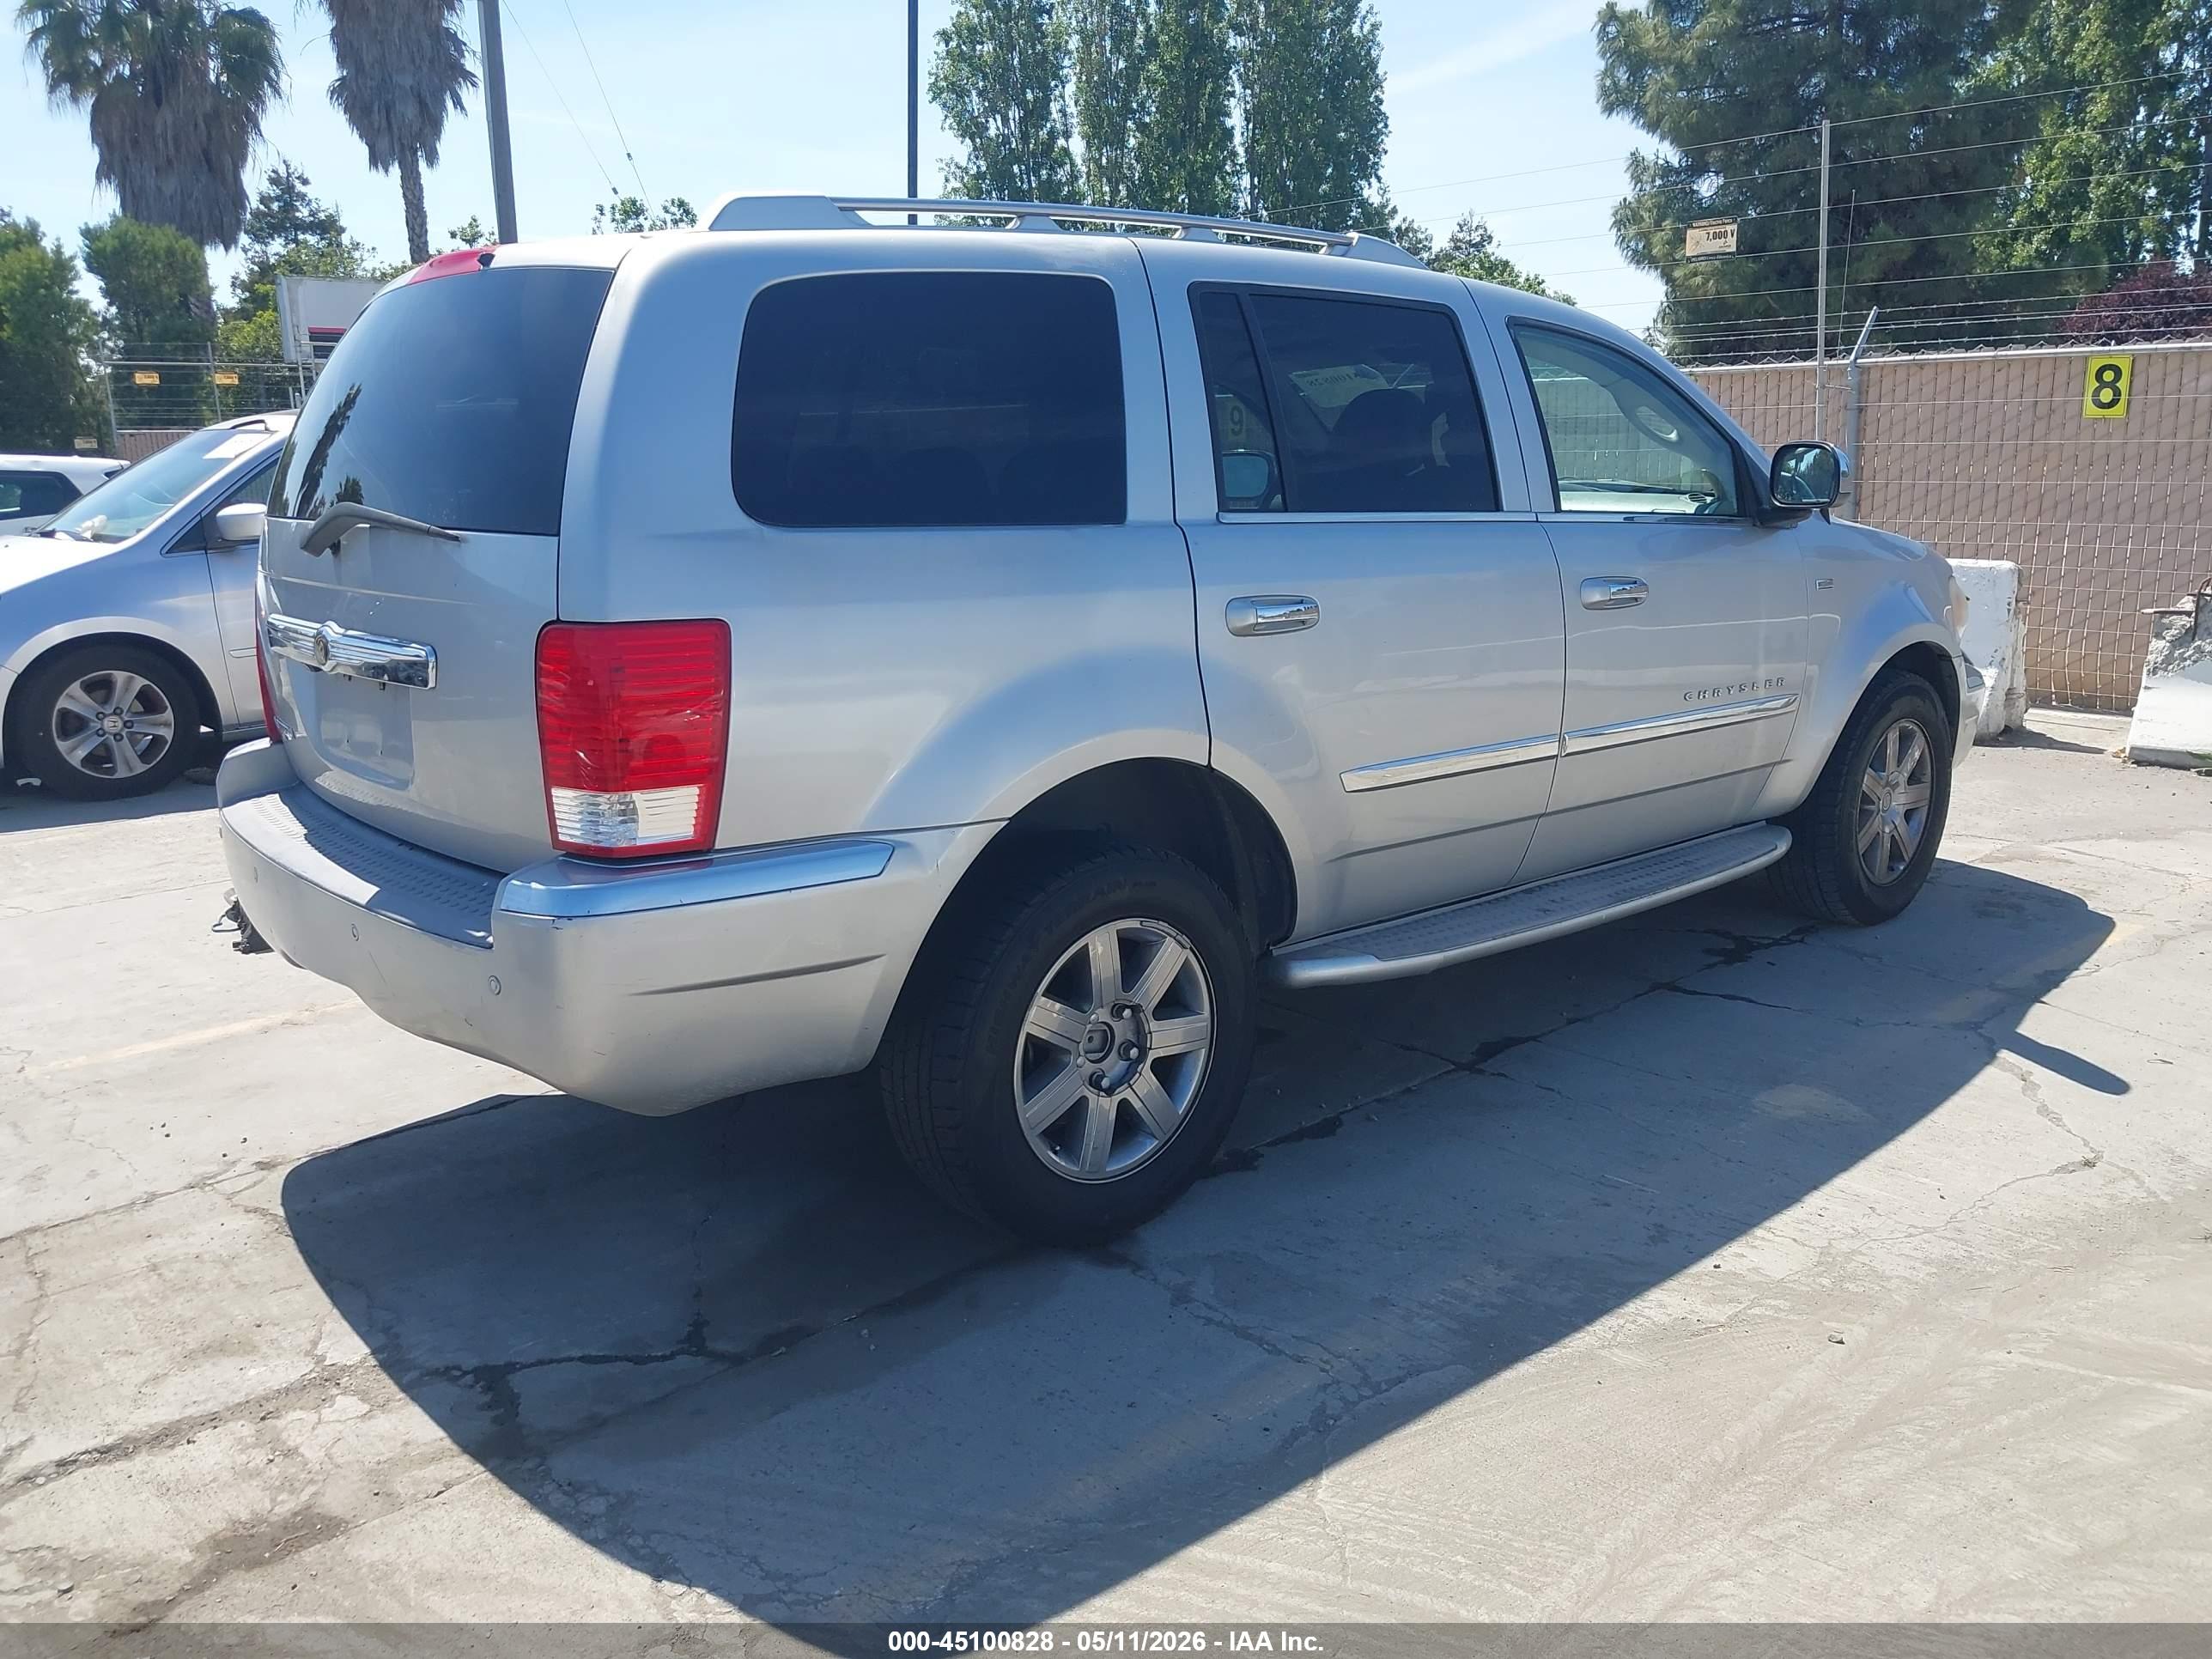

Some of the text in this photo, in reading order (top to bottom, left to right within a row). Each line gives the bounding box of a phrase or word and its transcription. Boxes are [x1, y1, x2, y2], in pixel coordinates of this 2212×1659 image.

[1705, 229, 1728, 242] 7,000
[1730, 228, 1735, 239] V
[2091, 363, 2123, 410] 8
[1230, 405, 1243, 436] 9
[1683, 677, 1786, 702] CHRYSLER
